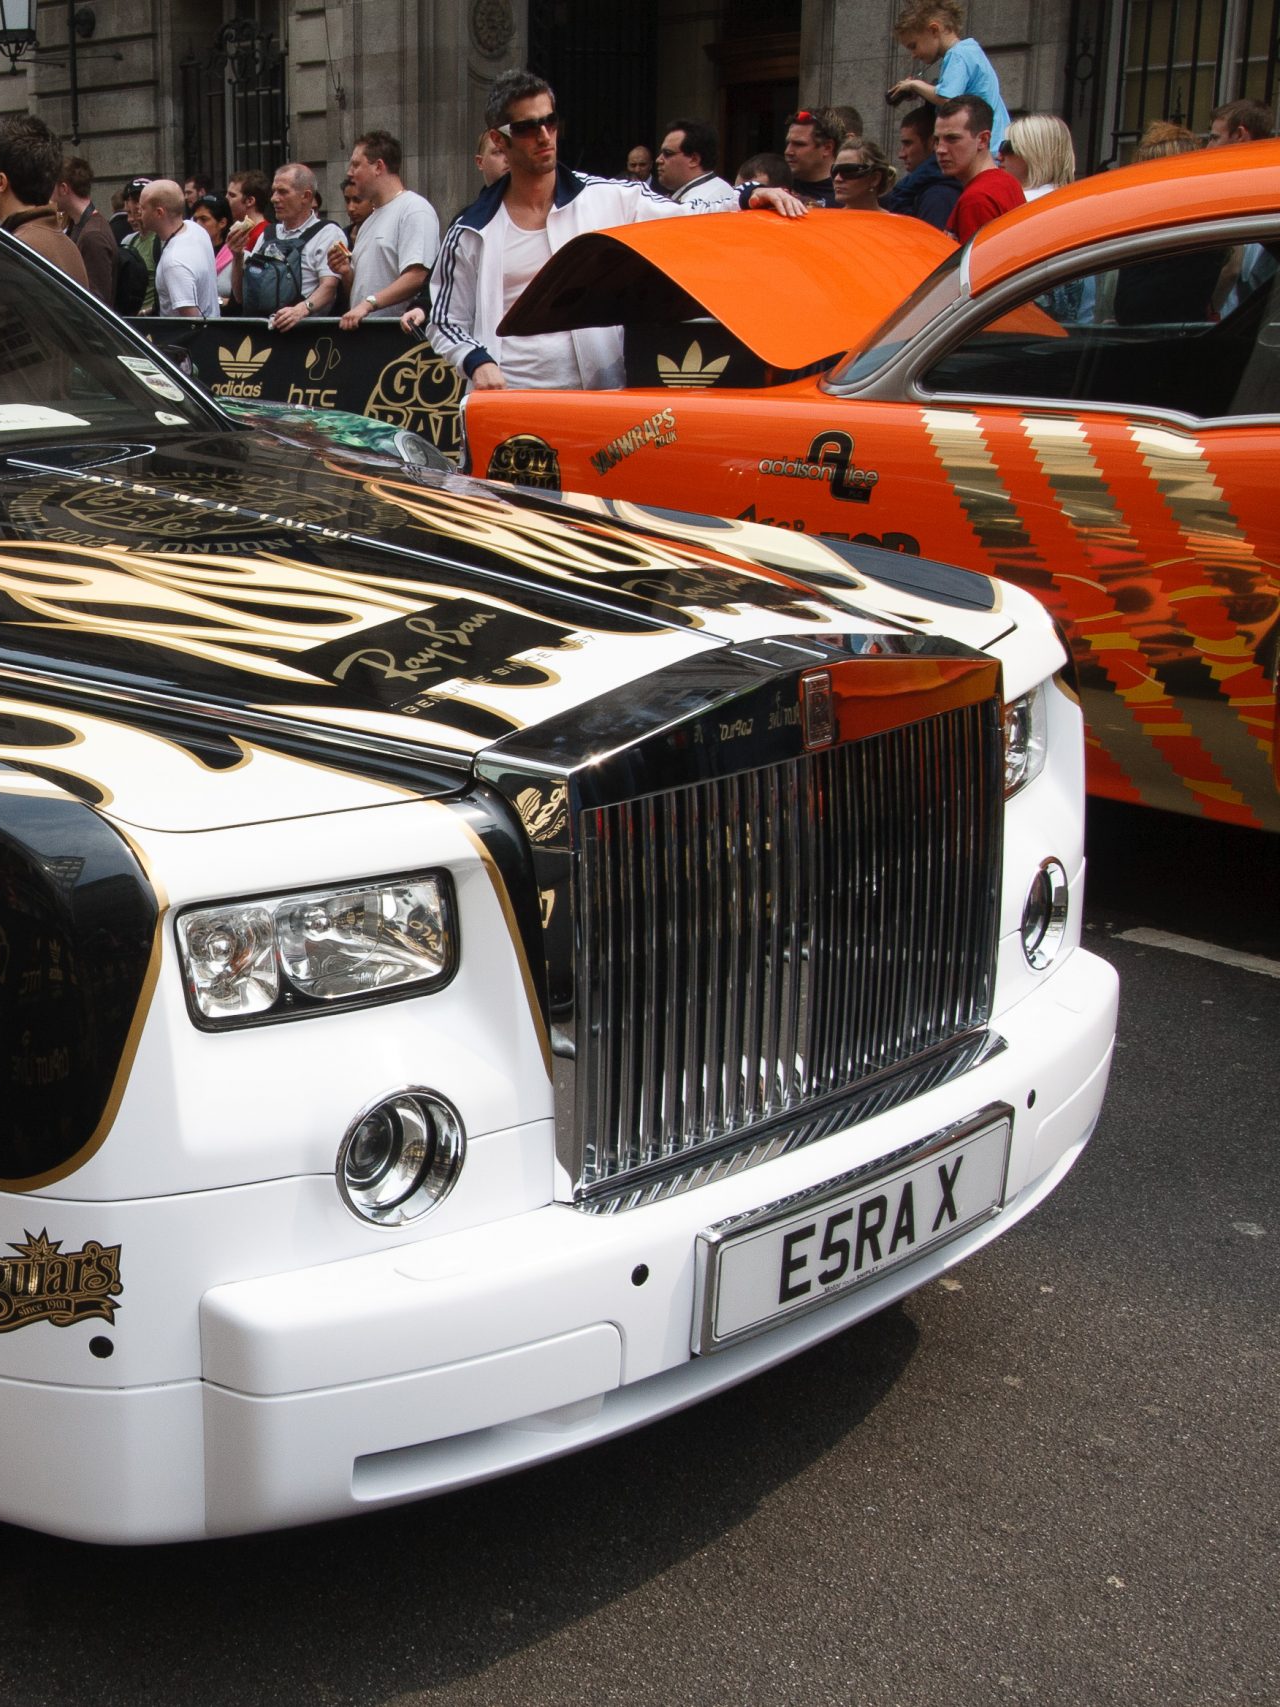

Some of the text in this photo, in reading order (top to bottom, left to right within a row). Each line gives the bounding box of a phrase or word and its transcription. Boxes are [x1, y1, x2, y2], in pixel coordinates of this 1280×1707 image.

[211, 380, 264, 398] adidas
[589, 407, 677, 477] VANWRAPS
[758, 456, 879, 489] addison lee
[401, 675, 493, 716] GENUINE
[491, 650, 553, 677] SINCE
[779, 1154, 965, 1306] E5RA X
[18, 1299, 67, 1316] since 1901
